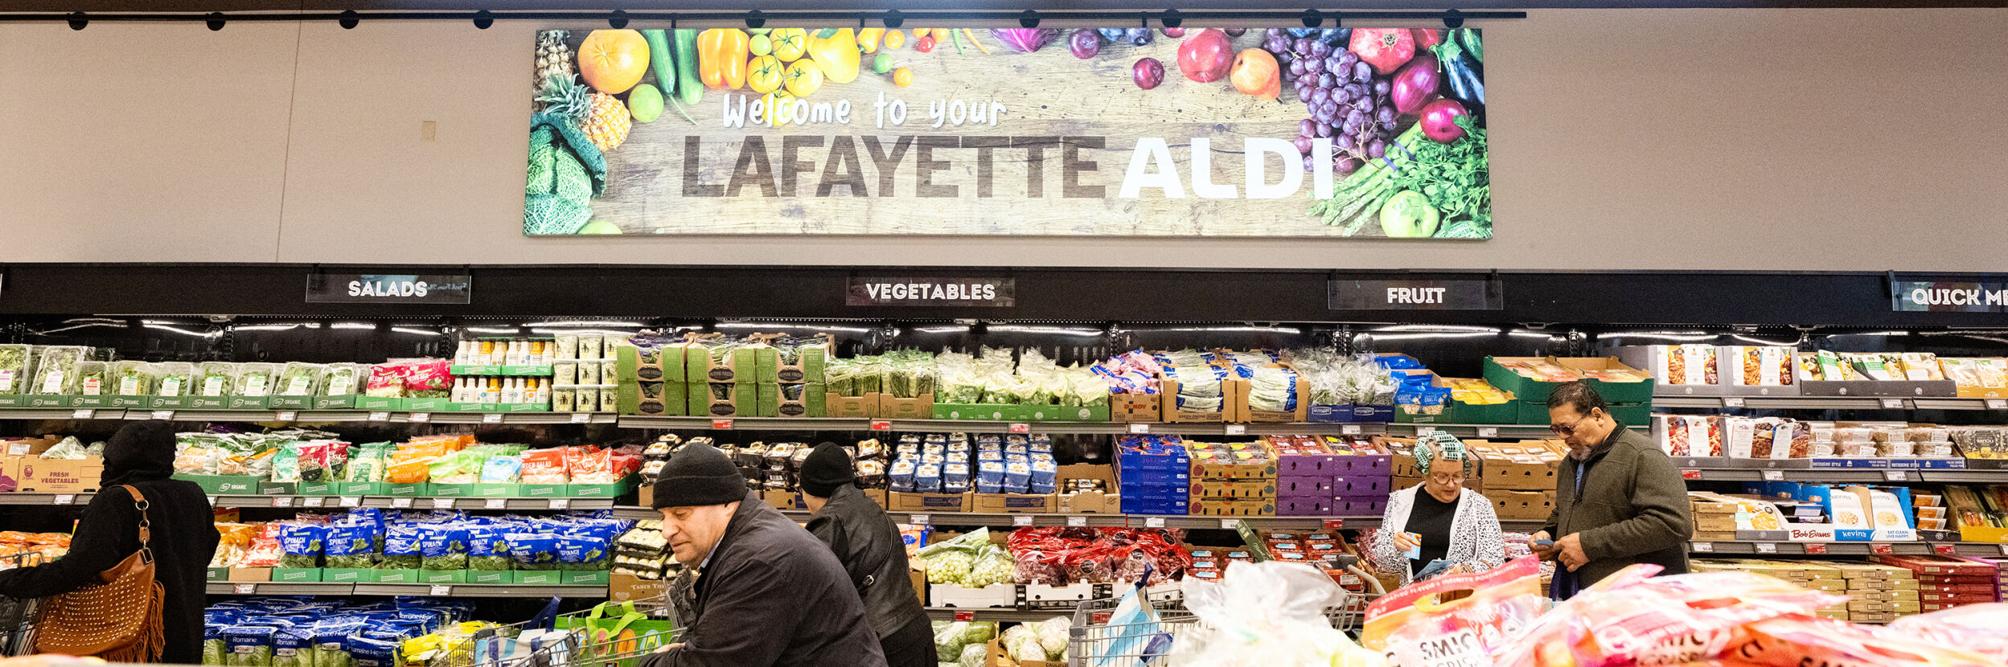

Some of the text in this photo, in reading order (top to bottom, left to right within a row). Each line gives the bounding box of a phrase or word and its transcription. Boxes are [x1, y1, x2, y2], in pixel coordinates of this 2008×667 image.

[722, 91, 1007, 129] Welcome to your
[682, 135, 1335, 200] LAFAYETTE ALDI
[348, 280, 428, 298] SALADS
[866, 283, 996, 300] VEGETABLES
[1387, 287, 1446, 304] FRUIT
[1911, 288, 1981, 306] QUICK
[1791, 529, 1831, 538] Bob Evans
